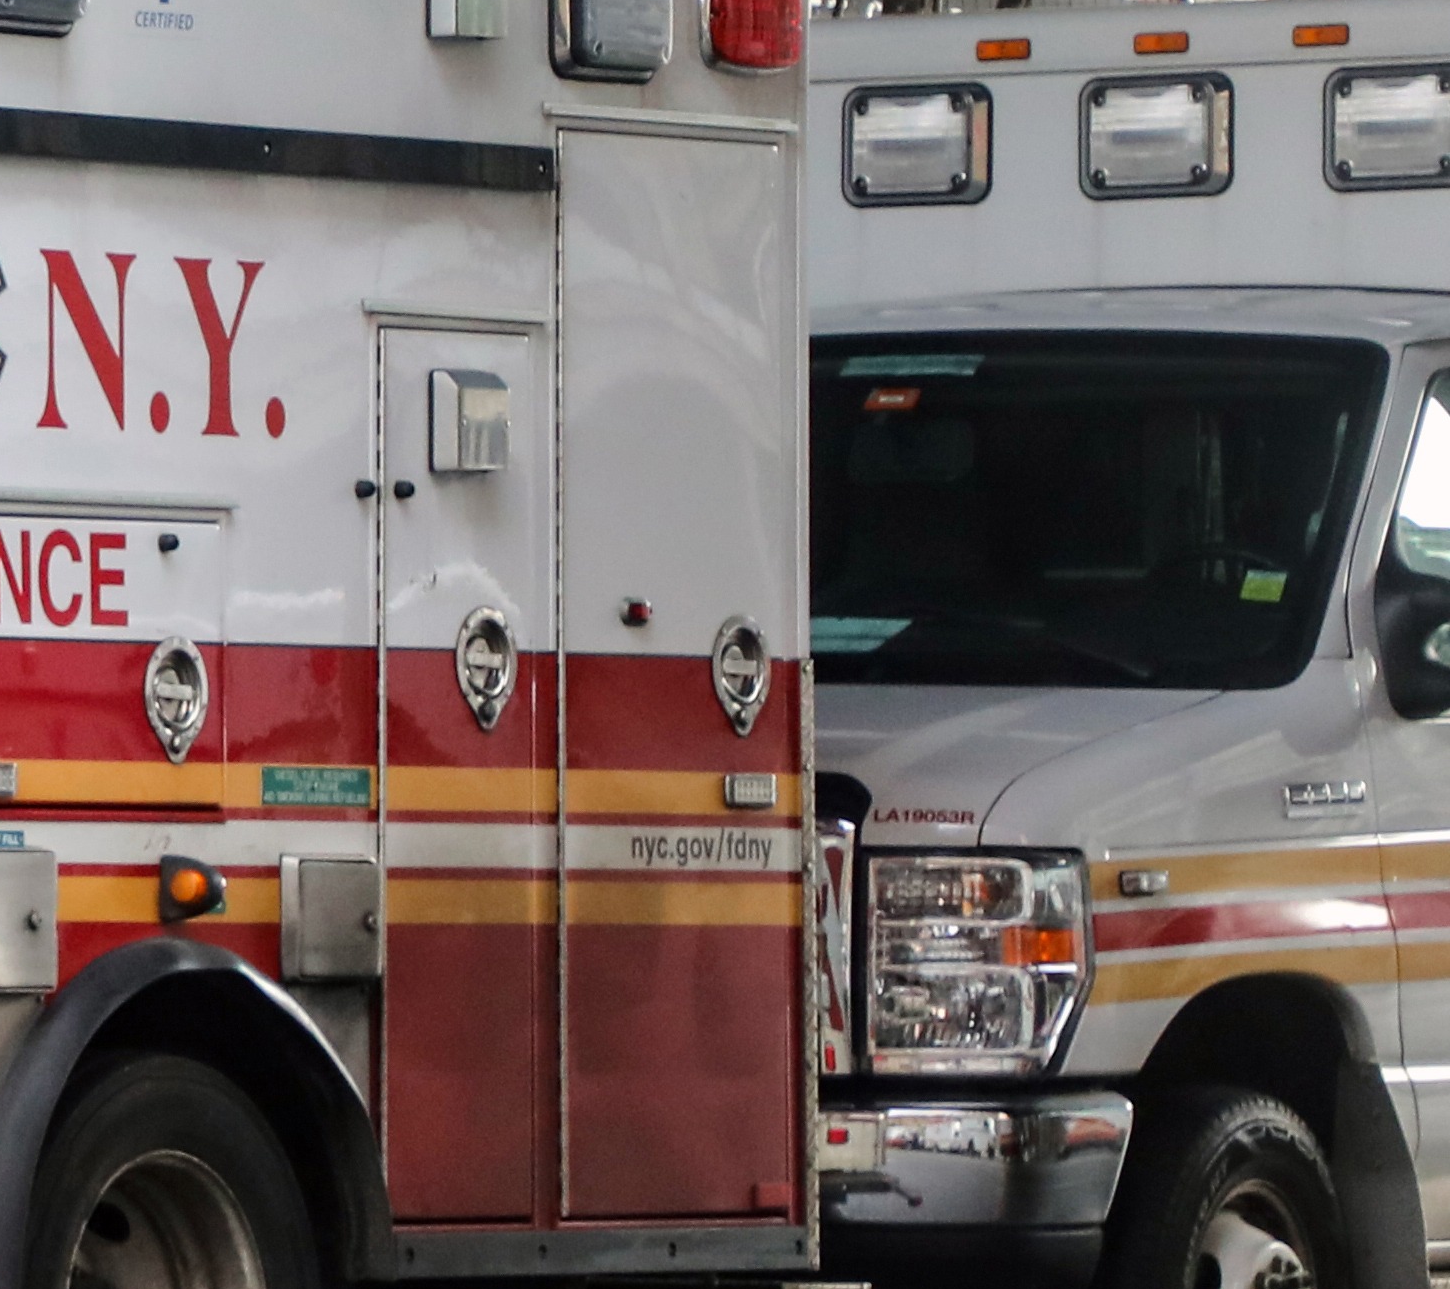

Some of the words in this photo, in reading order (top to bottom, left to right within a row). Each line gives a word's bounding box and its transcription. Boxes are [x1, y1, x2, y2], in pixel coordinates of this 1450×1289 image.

[135, 11, 194, 31] CERTIFIED
[36, 247, 287, 440] N.Y.
[631, 826, 773, 870] nyc.gov/fdny
